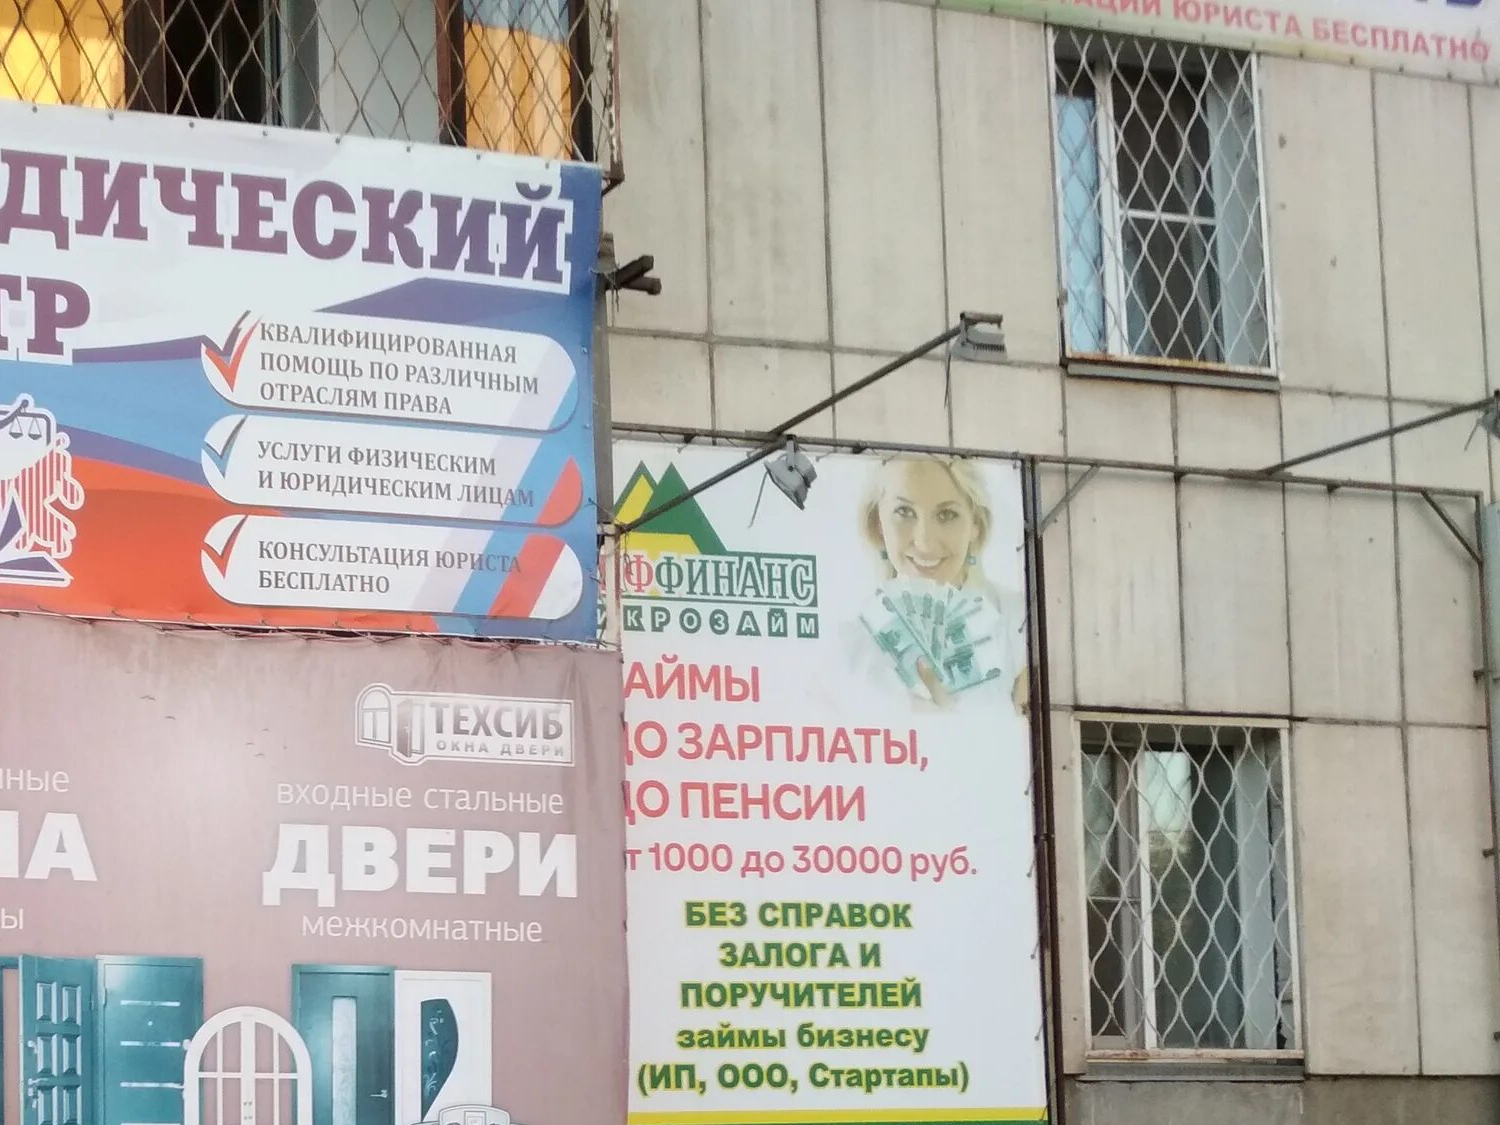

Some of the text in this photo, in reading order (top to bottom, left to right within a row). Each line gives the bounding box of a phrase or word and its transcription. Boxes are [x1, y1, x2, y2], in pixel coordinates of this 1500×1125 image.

[1173, 0, 1491, 62] ЮРИСТА БЕСПЛАТНО
[260, 322, 517, 364] КВАЛИФИЦИРОВАННАЯ
[260, 352, 539, 395] ПОМОЩЬ ПО РАЗЛИЧНЫМ
[260, 382, 452, 416] ОТРАСЛЯМ ПРАВА
[258, 441, 496, 476] УСЛУГИ ФИЗИЧЕСКИМ
[258, 470, 534, 509] И ЮРИДИЧЕСКИМ ЛИЦАМ
[258, 541, 521, 573] КОНСУЛЬТАЦИЯ ЮРИСТА
[258, 570, 390, 594] БЕСПЛАТНО
[598, 554, 816, 602] ФФИНАНС
[429, 702, 563, 740] ТЕХСИБ
[436, 740, 564, 757] ОКНА ДВЕРИ
[678, 722, 928, 771] ЗАРПЛАТЫ,
[277, 778, 563, 815] входные стальные
[680, 781, 866, 824] ПЕНСИИ
[262, 823, 579, 907] ДВЕРИ
[649, 842, 734, 872] 1000
[741, 849, 785, 877] до
[792, 845, 902, 876] 30000
[910, 846, 978, 882] руб.
[302, 909, 543, 943] межкомнатные
[685, 901, 912, 929] БЕЗ СПРАВОК
[719, 942, 881, 968] ЗАЛОГА И
[681, 977, 922, 1009] ПОРУЧИТЕЛЕЙ
[677, 1022, 929, 1052] займы бизнесу
[638, 1062, 969, 1096] (ИП, ООО, Стартапы)
